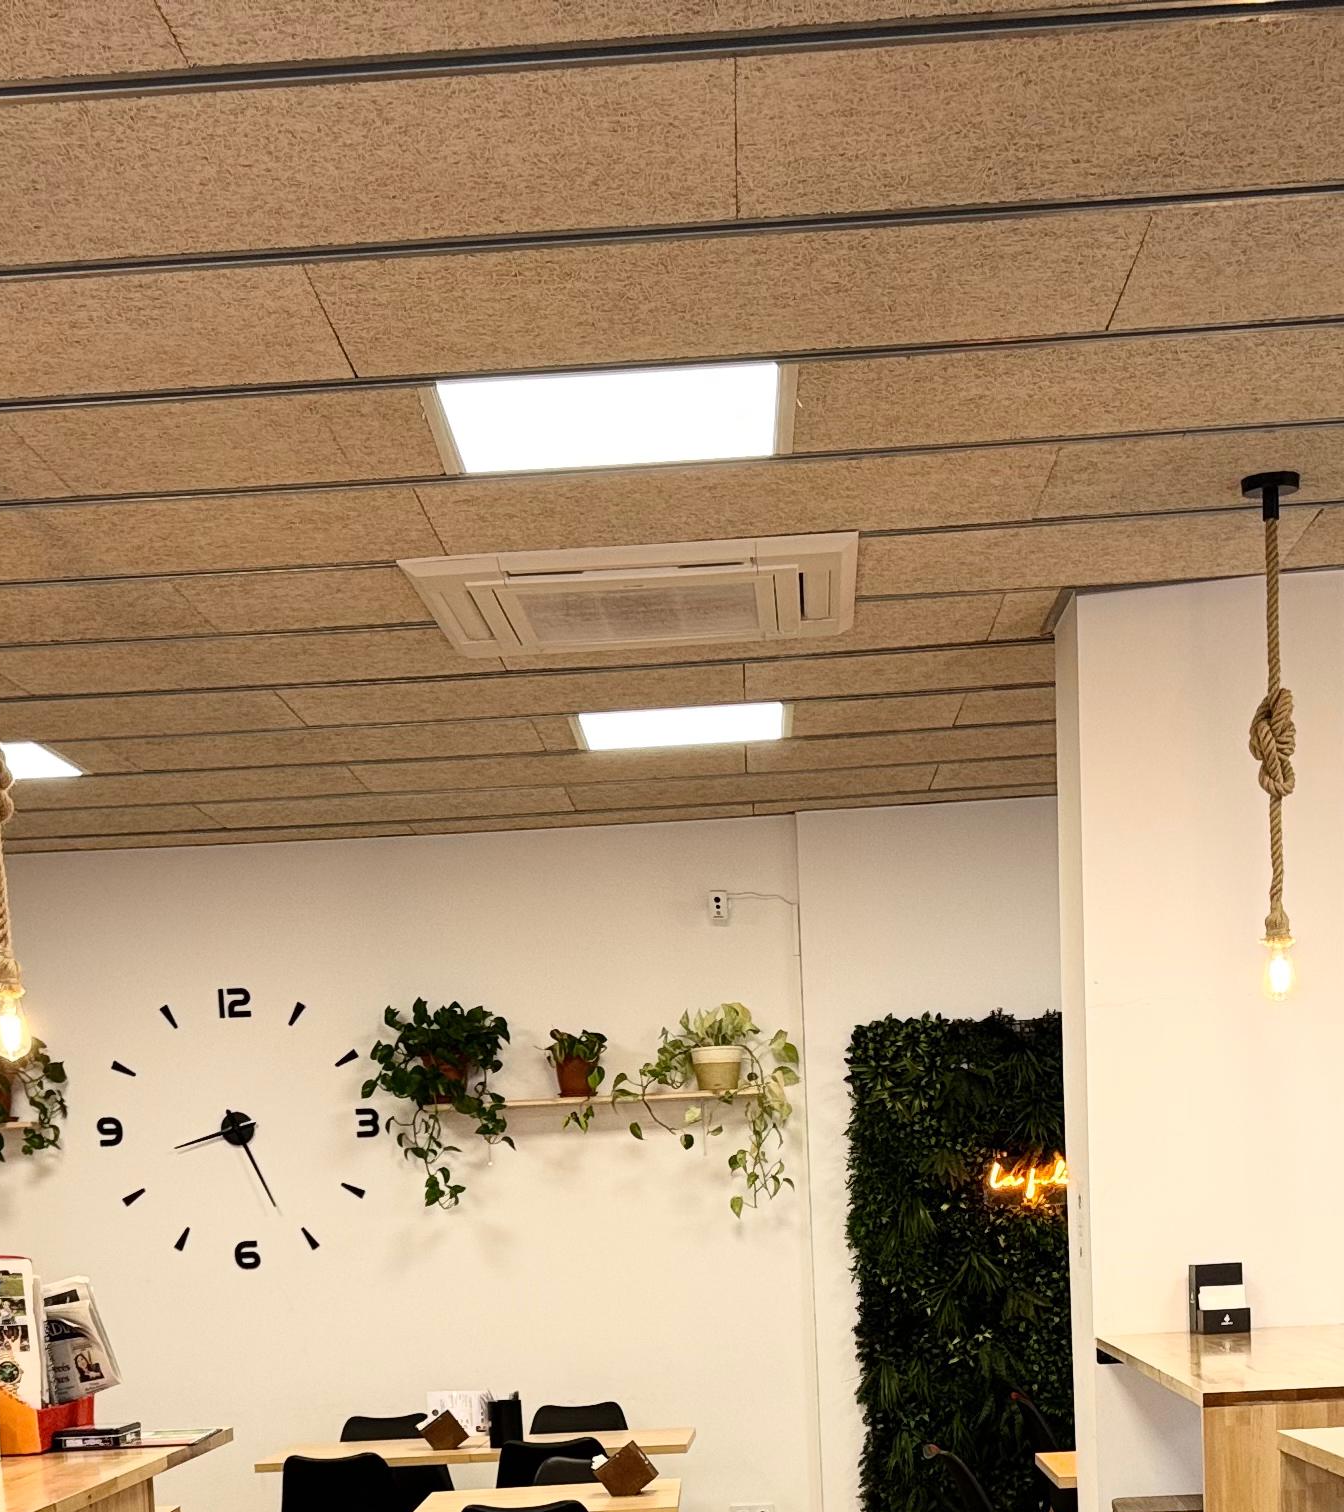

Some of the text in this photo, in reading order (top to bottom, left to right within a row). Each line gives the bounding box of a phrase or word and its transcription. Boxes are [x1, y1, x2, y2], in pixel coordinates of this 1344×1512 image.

[218, 988, 252, 1019] 12
[96, 1117, 123, 1147] 9
[355, 1108, 380, 1138] 3
[235, 1240, 261, 1270] 6
